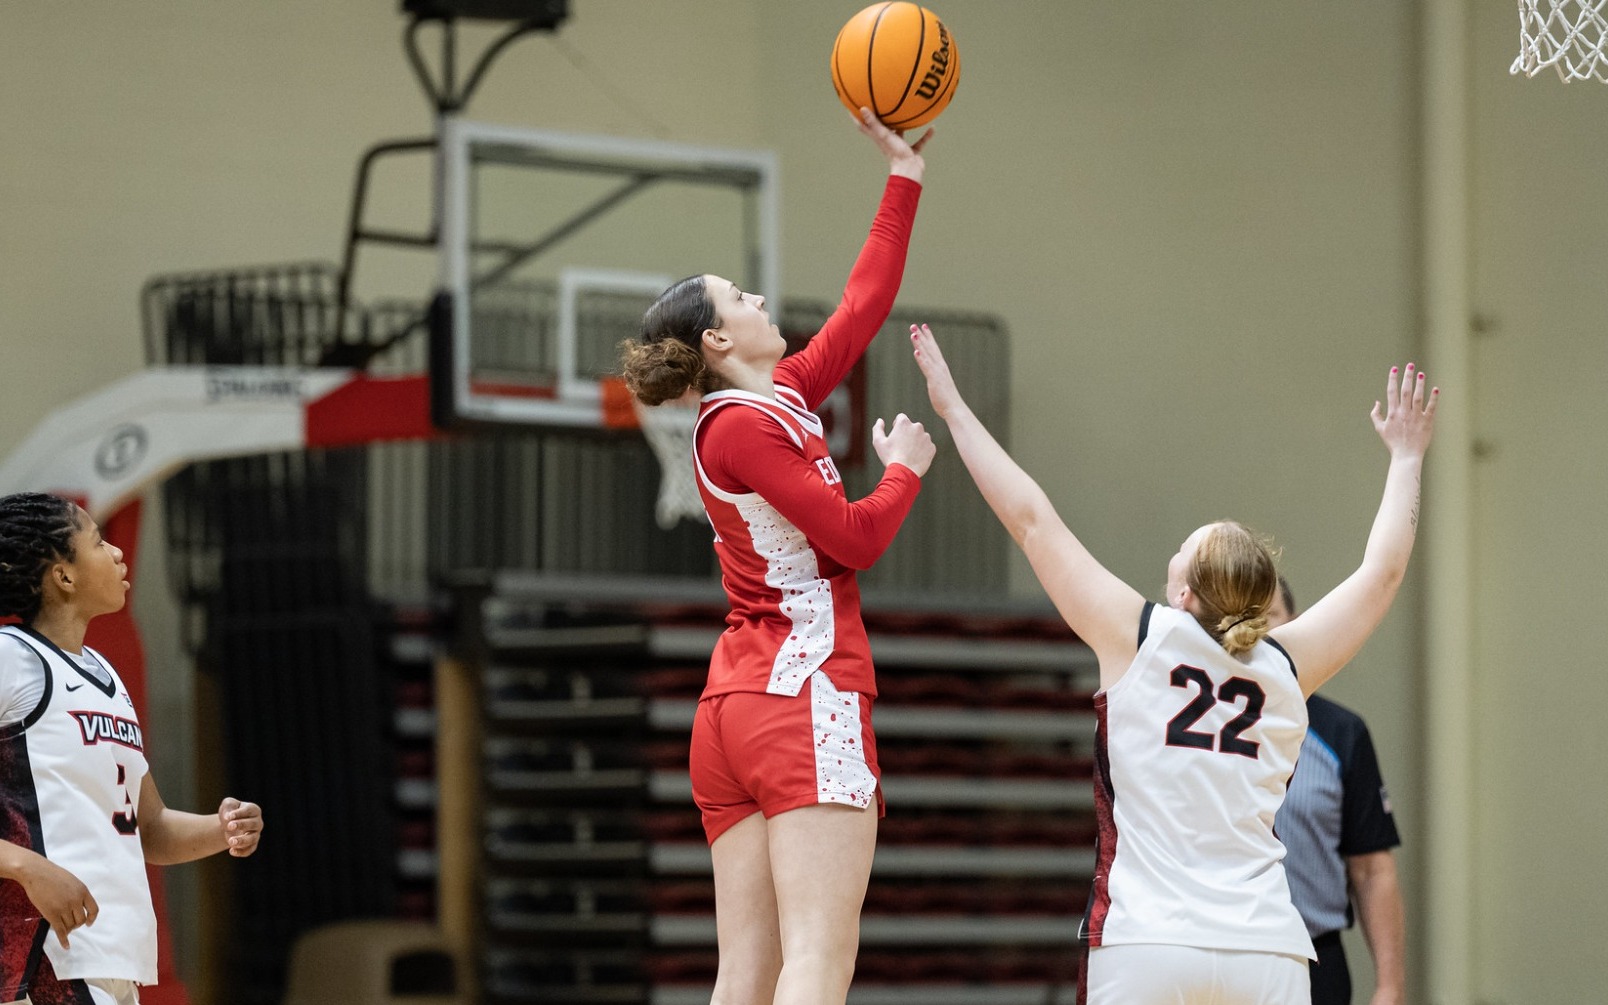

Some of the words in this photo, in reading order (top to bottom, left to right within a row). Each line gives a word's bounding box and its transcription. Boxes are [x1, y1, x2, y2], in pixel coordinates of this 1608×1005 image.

[914, 20, 950, 100] Wilson
[1165, 663, 1266, 760] 22
[111, 763, 139, 836] 3
